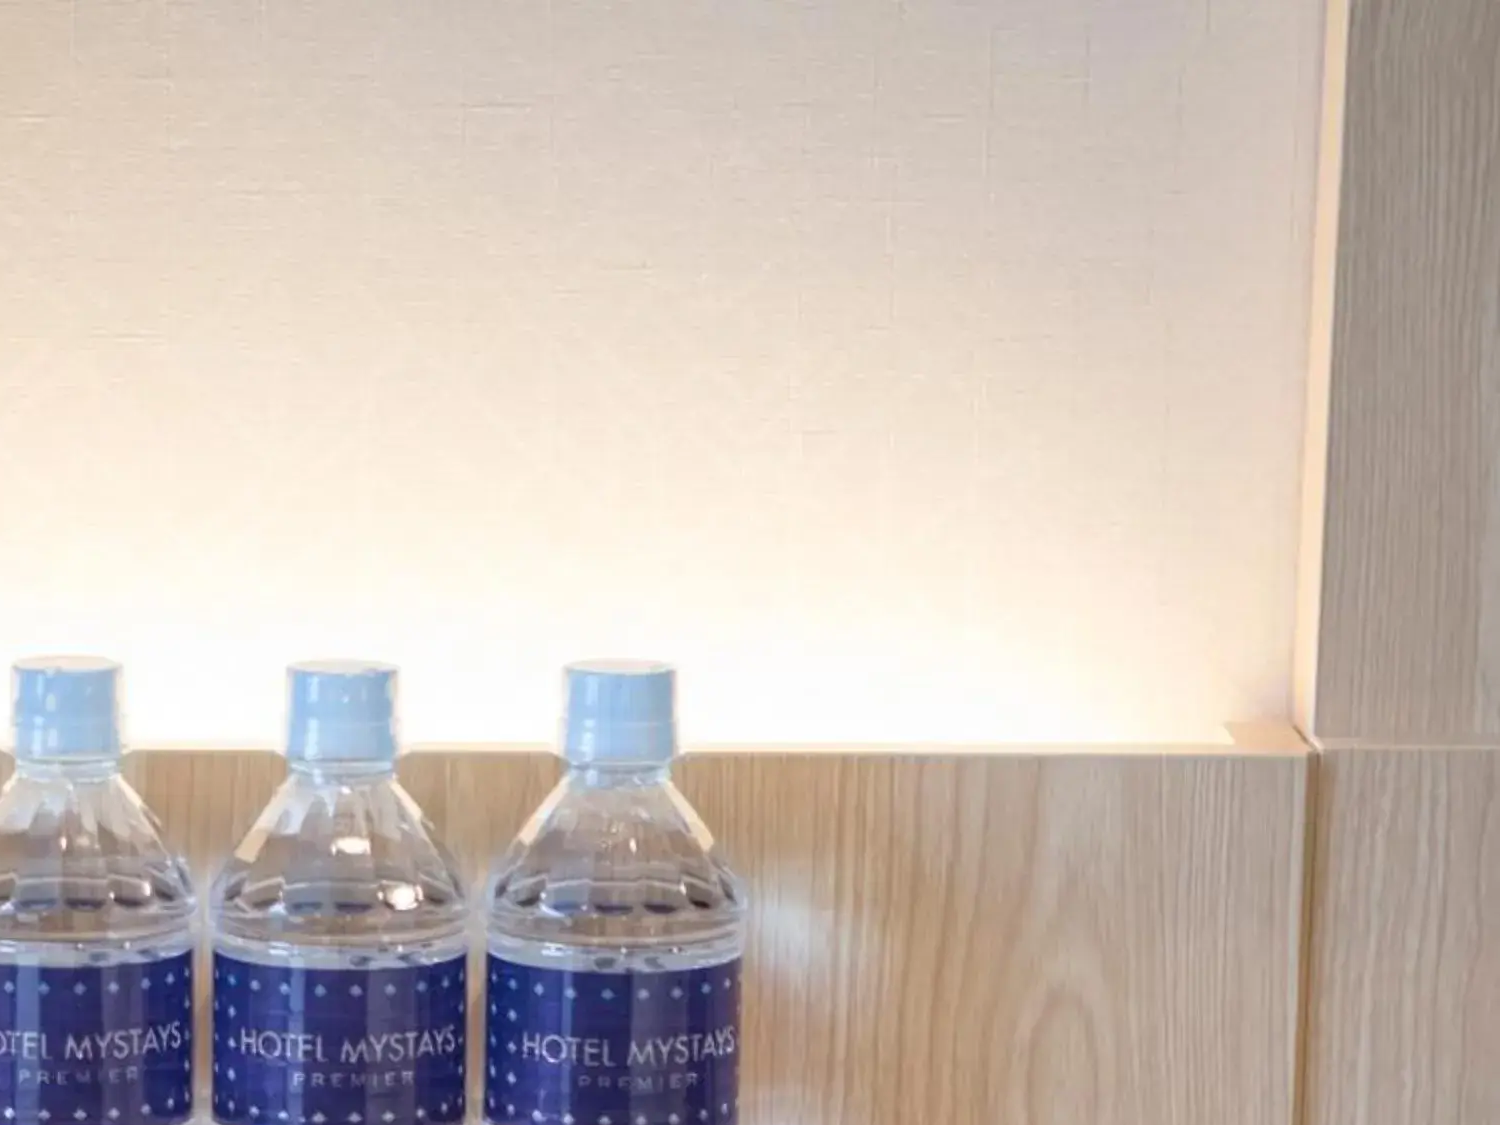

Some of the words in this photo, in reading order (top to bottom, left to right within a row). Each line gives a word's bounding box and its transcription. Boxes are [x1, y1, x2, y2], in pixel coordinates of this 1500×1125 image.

[64, 1021, 180, 1060] MYSTAYS
[241, 1027, 328, 1062] HOTEL
[340, 1024, 455, 1063] MYSTAYS
[522, 1032, 615, 1067] HOTEL
[627, 1025, 735, 1066] MYSTAYS
[19, 1066, 138, 1085] PREMER
[293, 1070, 414, 1087] PREMIER
[578, 1072, 698, 1091] PREMIER
